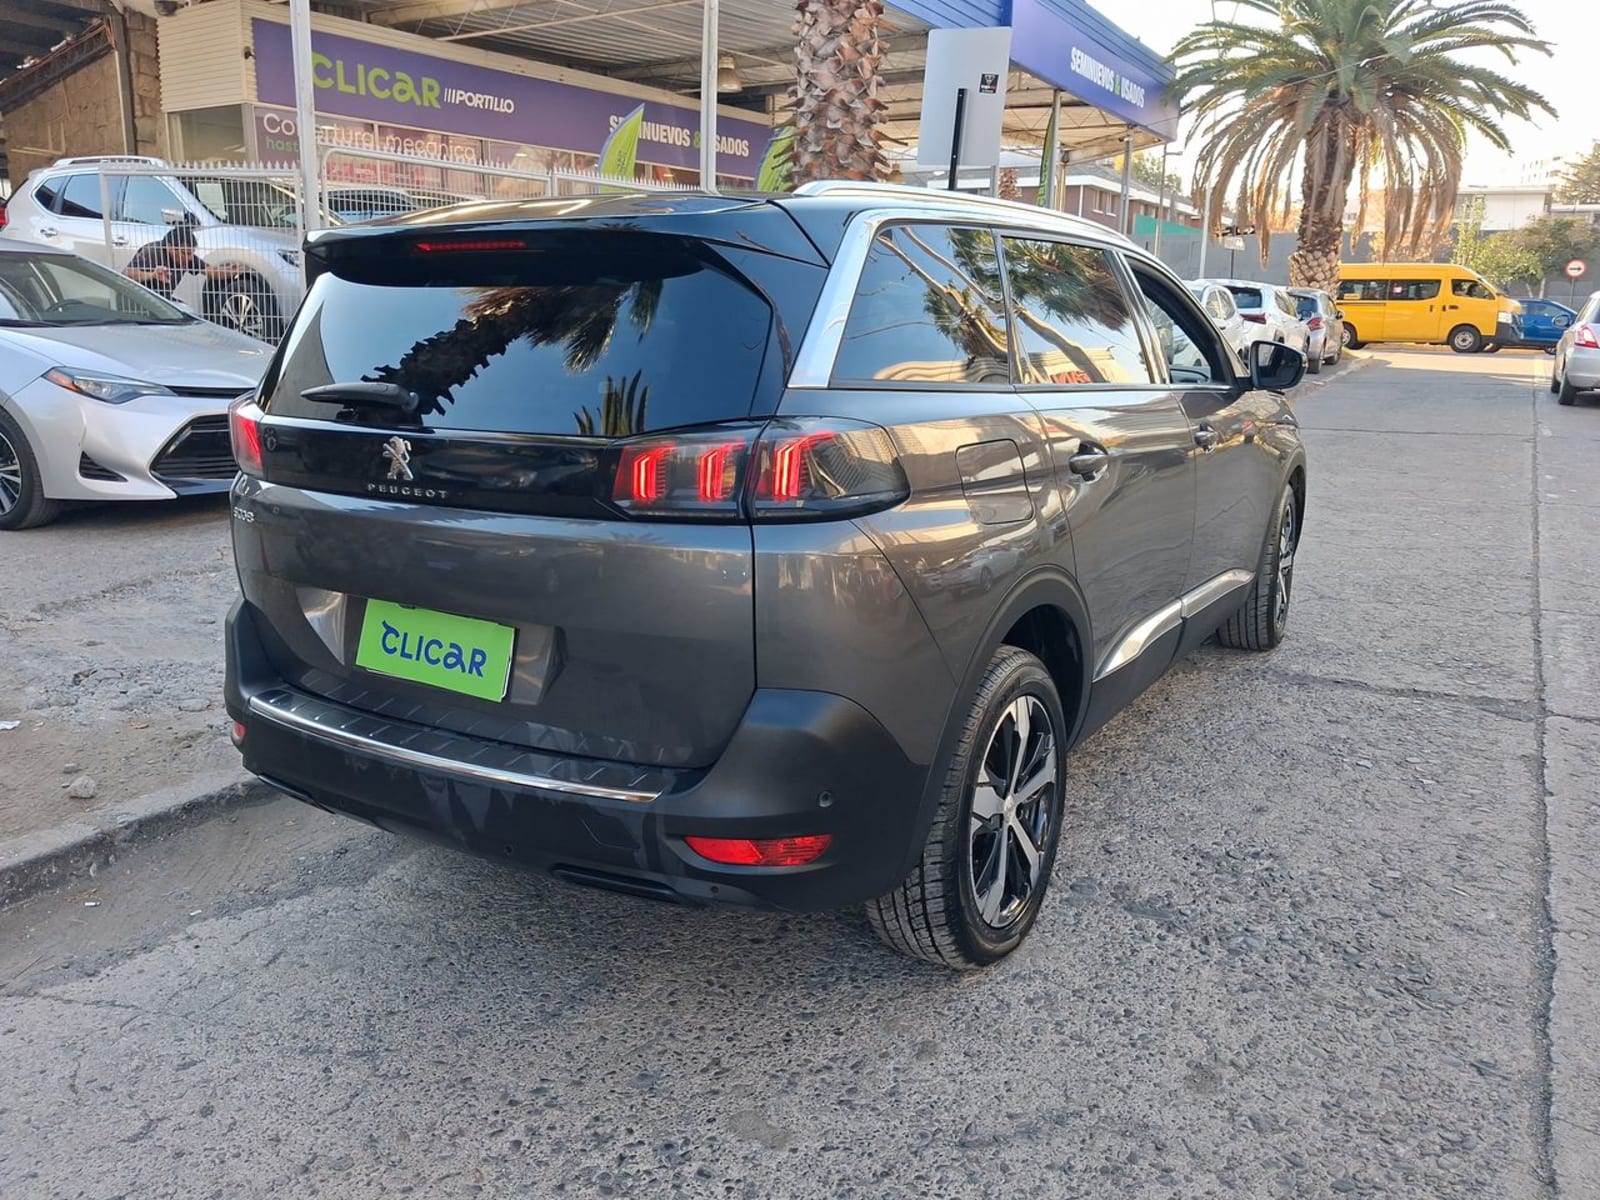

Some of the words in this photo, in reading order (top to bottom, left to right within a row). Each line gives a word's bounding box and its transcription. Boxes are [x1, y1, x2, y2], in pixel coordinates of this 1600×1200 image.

[1070, 46, 1115, 92] SEMINUEVOS
[1120, 76, 1145, 109] USADOS
[456, 89, 515, 114] PORTILLO
[714, 134, 749, 157] SADOS
[367, 483, 447, 499] PEUGEOT
